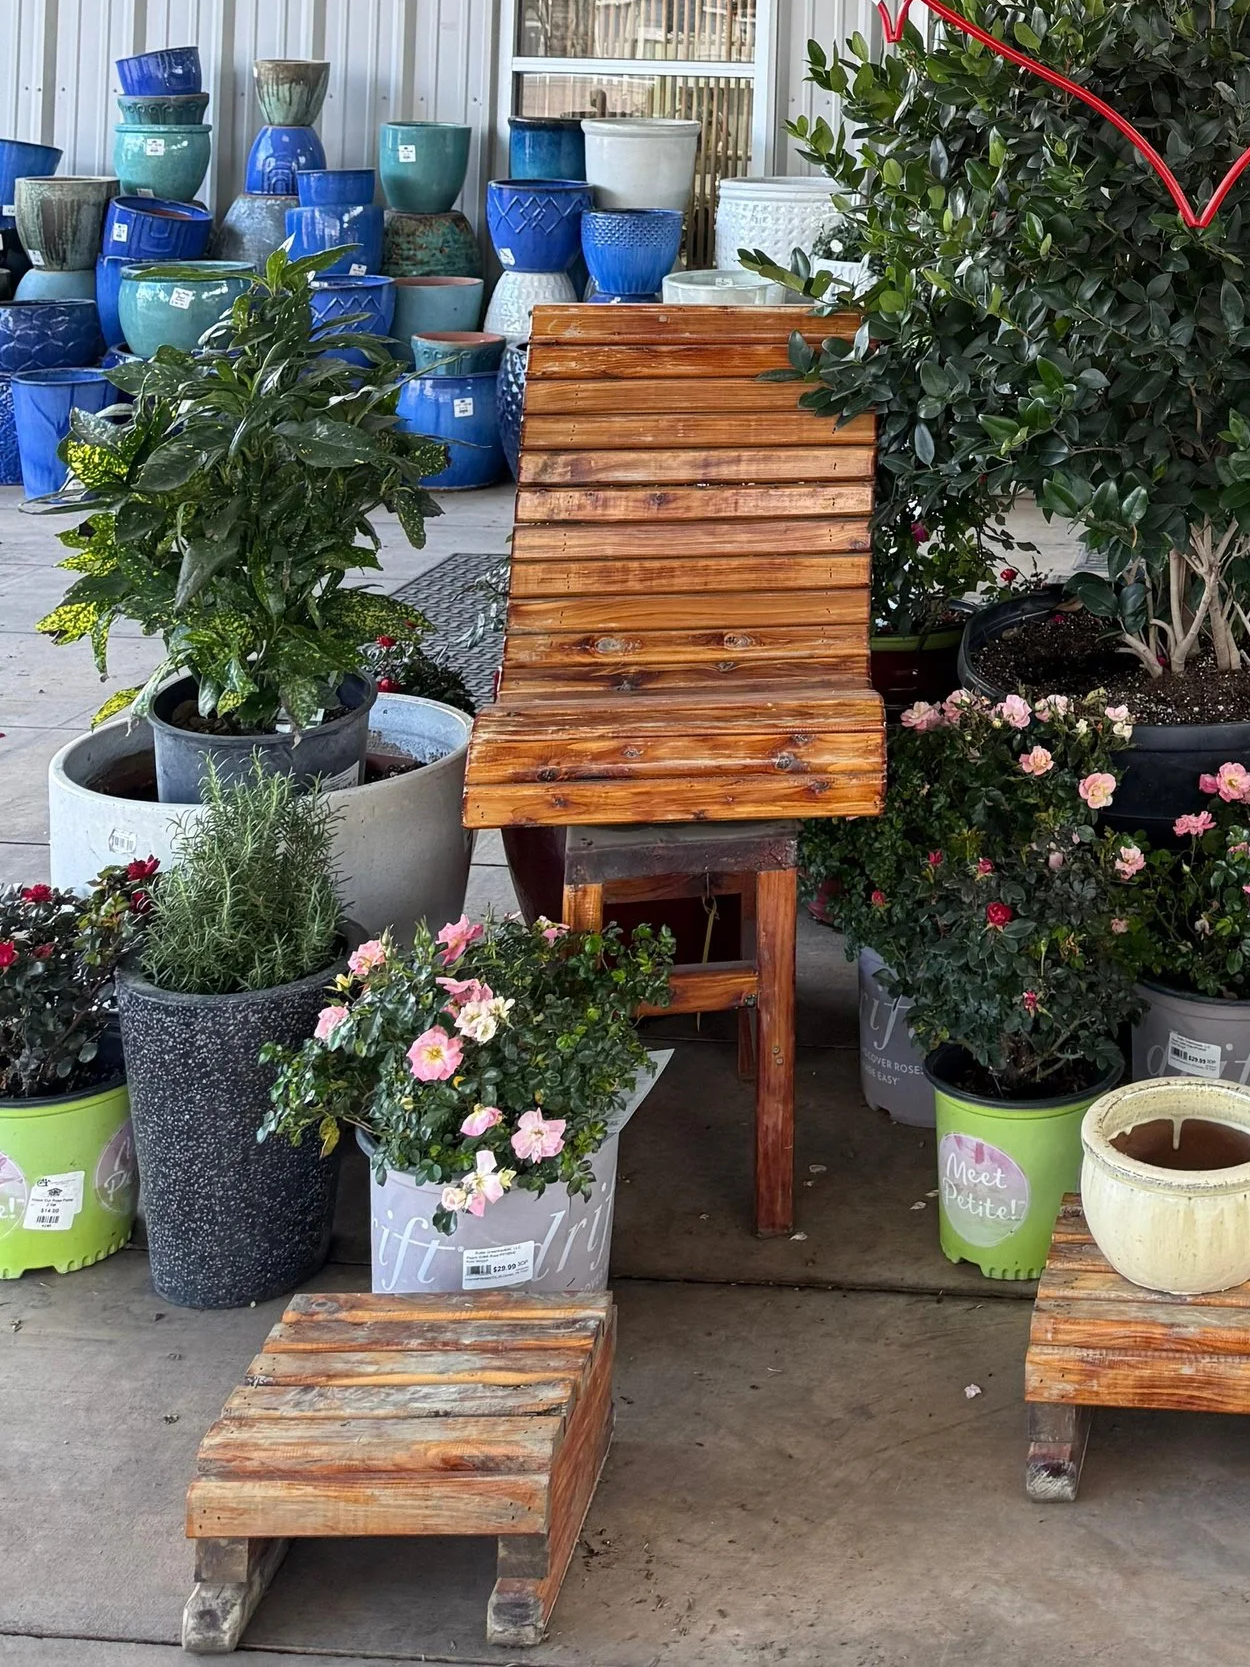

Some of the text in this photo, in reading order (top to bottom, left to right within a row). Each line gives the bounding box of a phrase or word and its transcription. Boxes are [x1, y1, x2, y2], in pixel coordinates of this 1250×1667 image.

[946, 1152, 1008, 1189] Meet
[942, 1176, 1018, 1220] Petite!
[373, 1209, 456, 1291] ift
